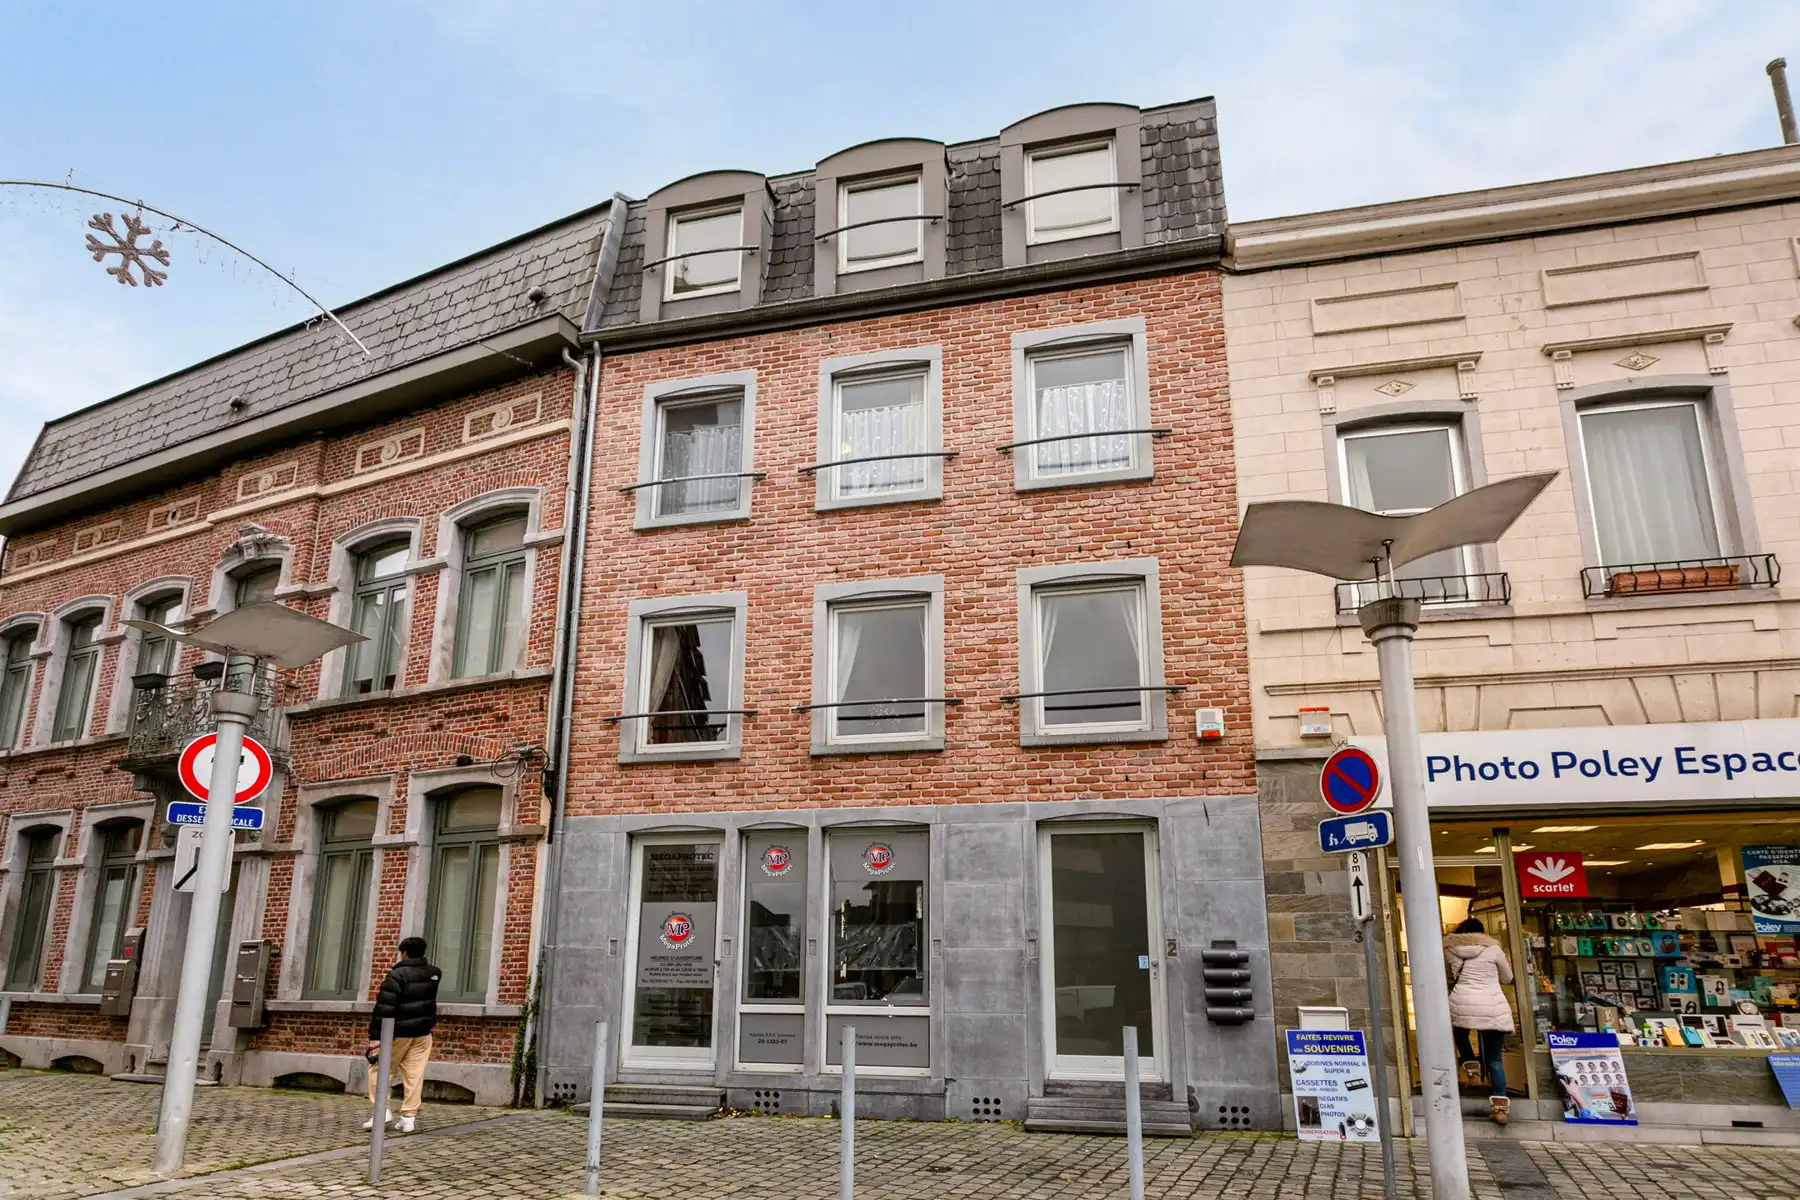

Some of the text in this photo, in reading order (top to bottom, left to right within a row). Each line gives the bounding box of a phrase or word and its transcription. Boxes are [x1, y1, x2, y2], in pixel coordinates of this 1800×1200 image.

[1426, 746, 1800, 783] Photo Poley Espac
[176, 813, 255, 827] DESSE CALE
[760, 863, 794, 877] MegaProtec
[862, 862, 897, 876] MegaProtec
[1352, 853, 1361, 873] 8 m
[1533, 882, 1575, 893] scarlet
[1755, 921, 1781, 933] Poley
[659, 933, 696, 950] MegaProtec
[1549, 1034, 1578, 1046] Poley
[1304, 1045, 1361, 1053] SOUVENIRS
